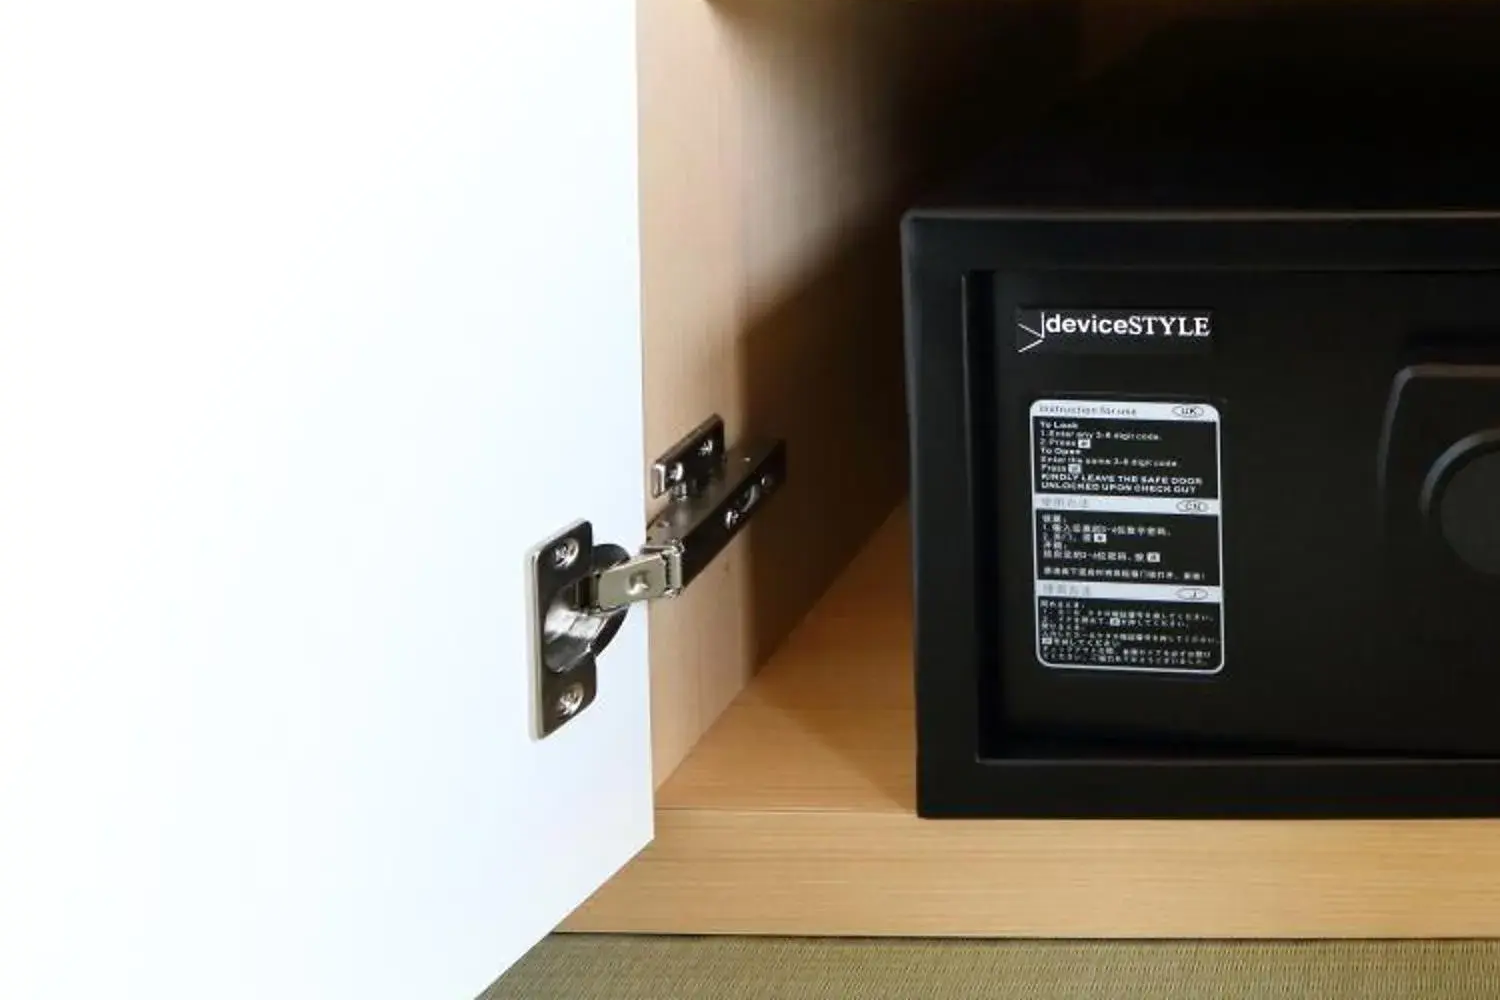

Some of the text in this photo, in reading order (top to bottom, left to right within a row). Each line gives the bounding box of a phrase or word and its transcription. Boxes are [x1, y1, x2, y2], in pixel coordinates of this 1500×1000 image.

[1045, 313, 1211, 337] deviceSTYLE
[1180, 408, 1198, 417] UK
[1040, 421, 1051, 429] To
[1054, 448, 1081, 457] Open
[1085, 458, 1111, 466] same
[1041, 464, 1066, 473] Press
[1041, 473, 1203, 486] KINDLY LEAVE THE SAFE DOOR
[1041, 481, 1100, 491] UNLOCKED
[1102, 483, 1133, 492] UPON
[1134, 484, 1171, 493] CHECK
